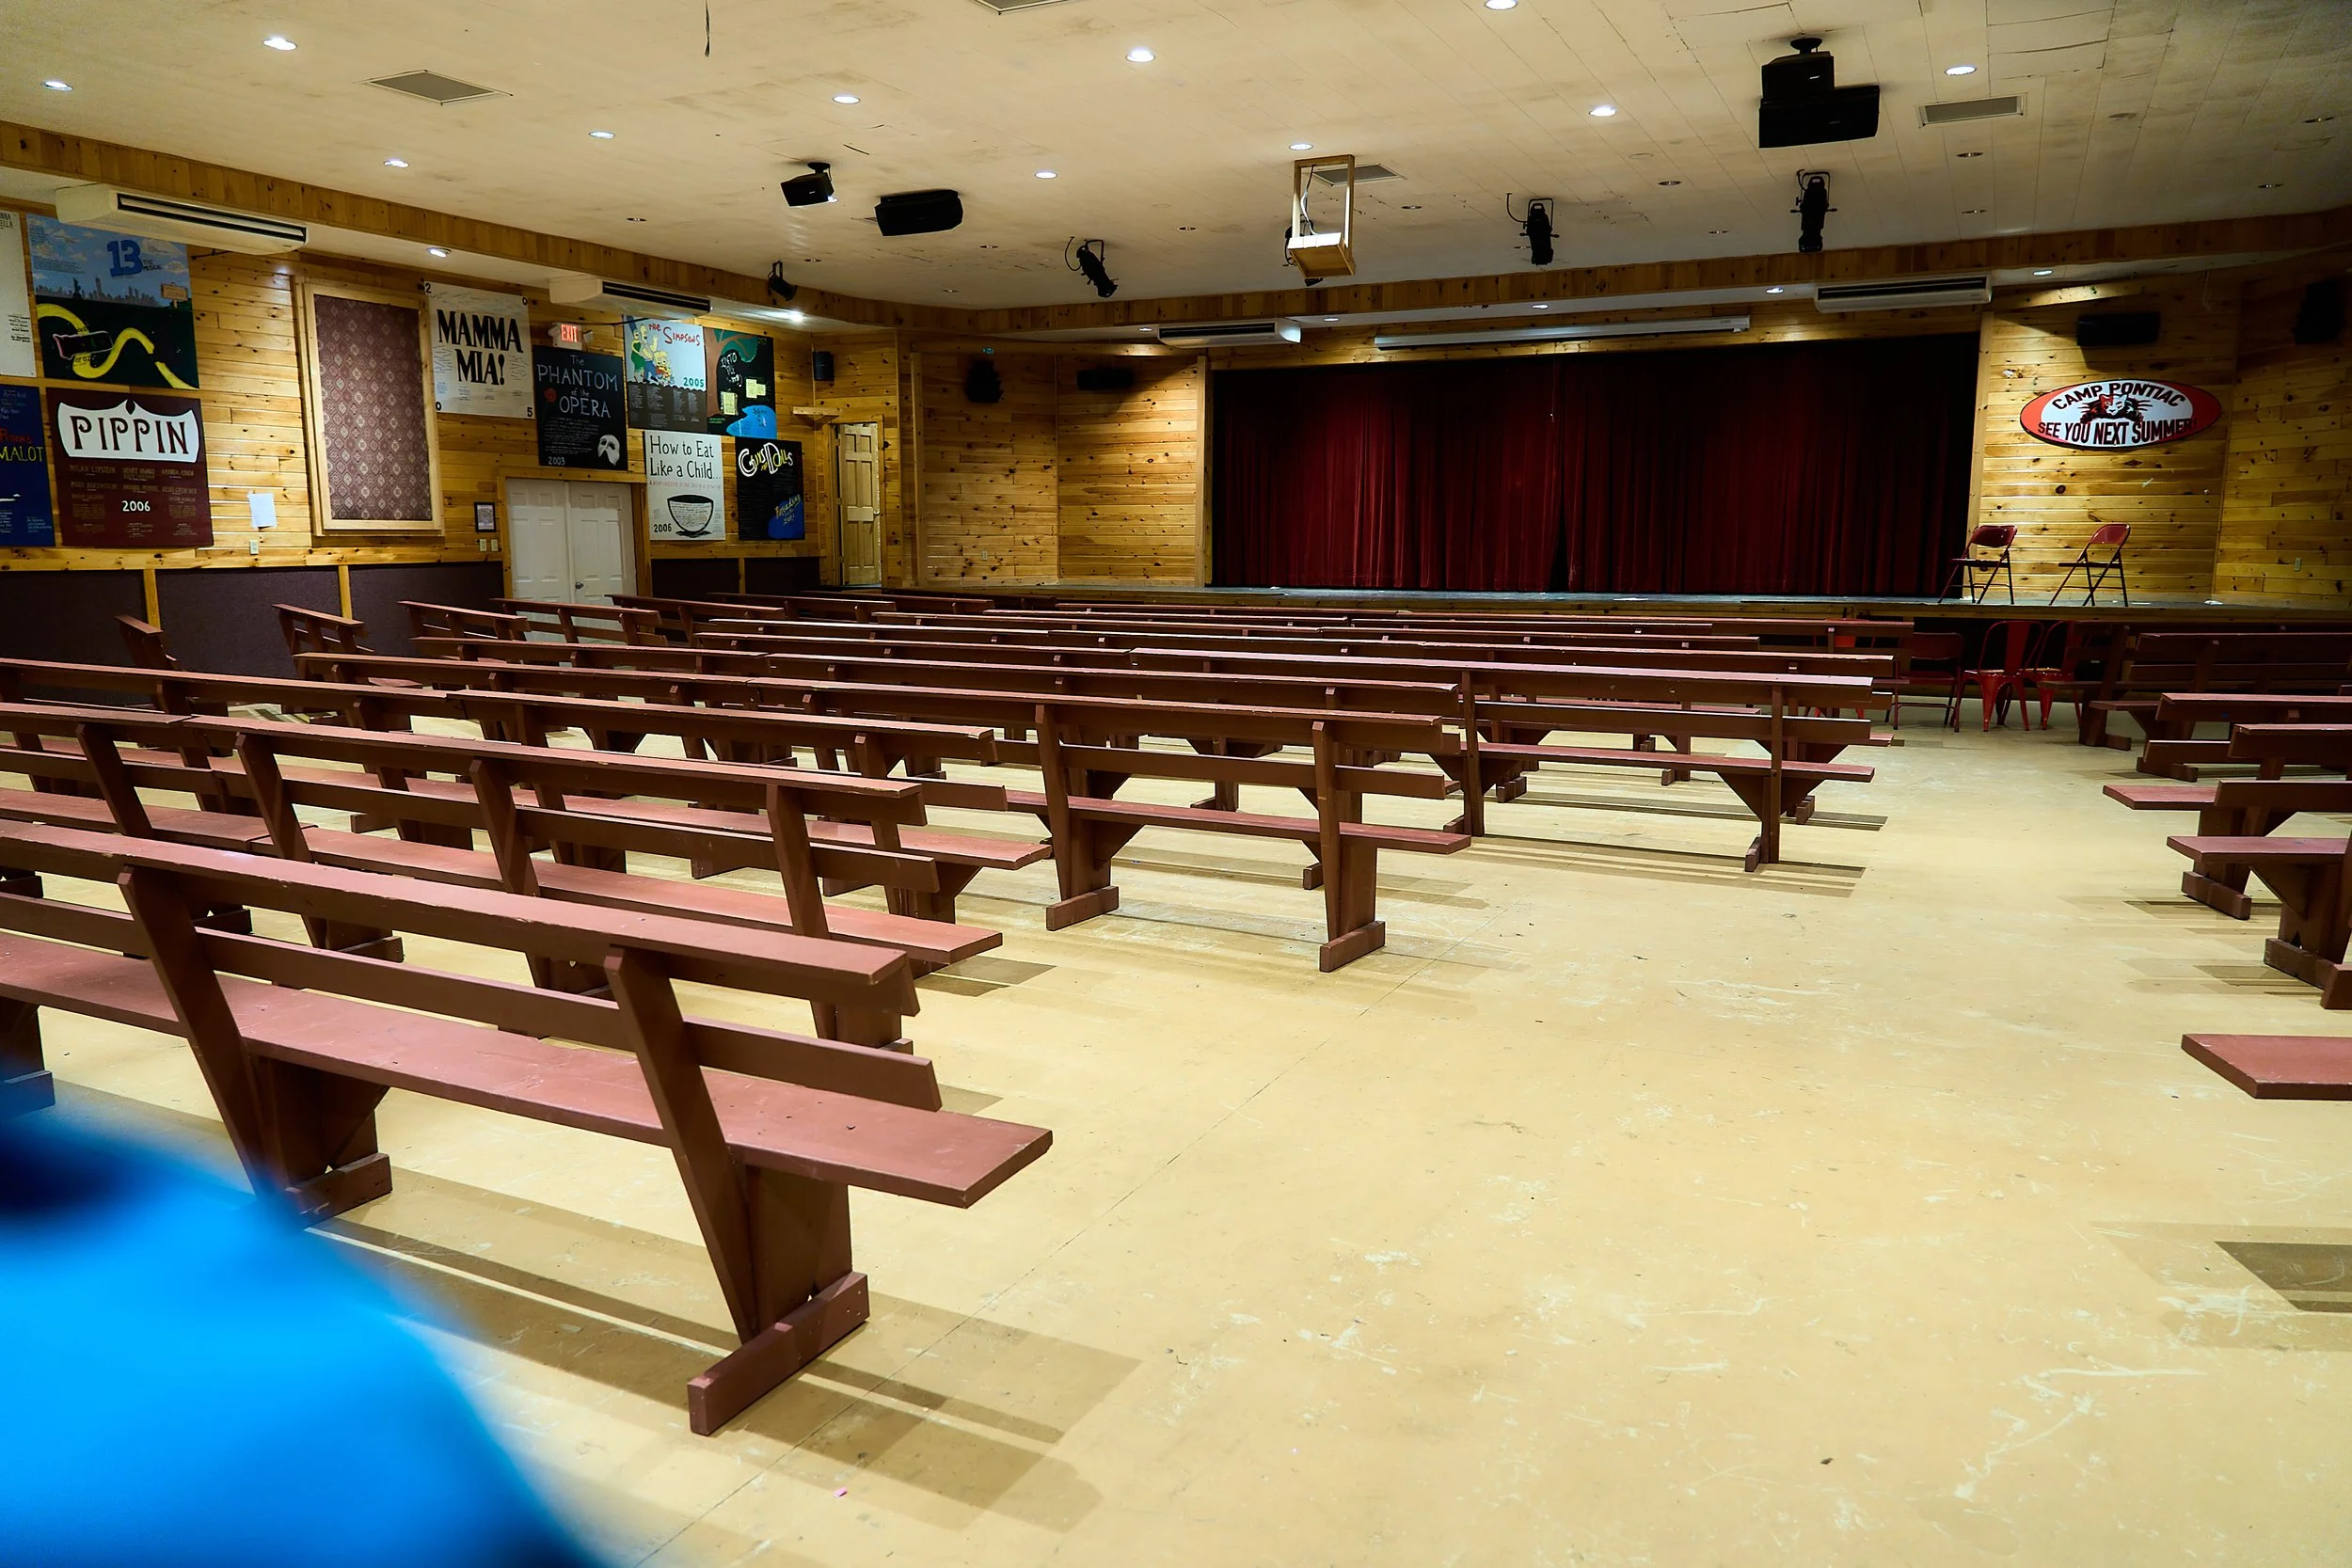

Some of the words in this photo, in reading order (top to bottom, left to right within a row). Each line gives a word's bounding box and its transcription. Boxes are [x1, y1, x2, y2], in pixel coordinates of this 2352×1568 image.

[106, 240, 143, 277] 13
[425, 283, 432, 293] 2
[437, 309, 523, 354] MAMMA
[561, 324, 578, 342] EXIT
[454, 349, 504, 386] MIA!
[570, 355, 584, 366] The
[536, 364, 618, 391] PHANTOM
[683, 377, 705, 388] 2005
[2052, 385, 2103, 410] CAMP
[2109, 382, 2186, 407] PONTIAC
[527, 407, 533, 417] 5
[559, 396, 612, 419] OPERA
[70, 415, 189, 454] PIPPIN
[2038, 421, 2064, 438] SEE
[2064, 422, 2091, 444] YOU
[2093, 421, 2130, 445] NEXT
[2132, 419, 2197, 443] SUMMER!
[649, 436, 679, 454] How
[682, 441, 692, 455] to
[695, 440, 714, 458] Eat
[548, 456, 565, 466] 2003
[650, 457, 674, 477] Like
[676, 465, 683, 477] a
[122, 500, 151, 512] 2006
[653, 523, 673, 533] 2006
